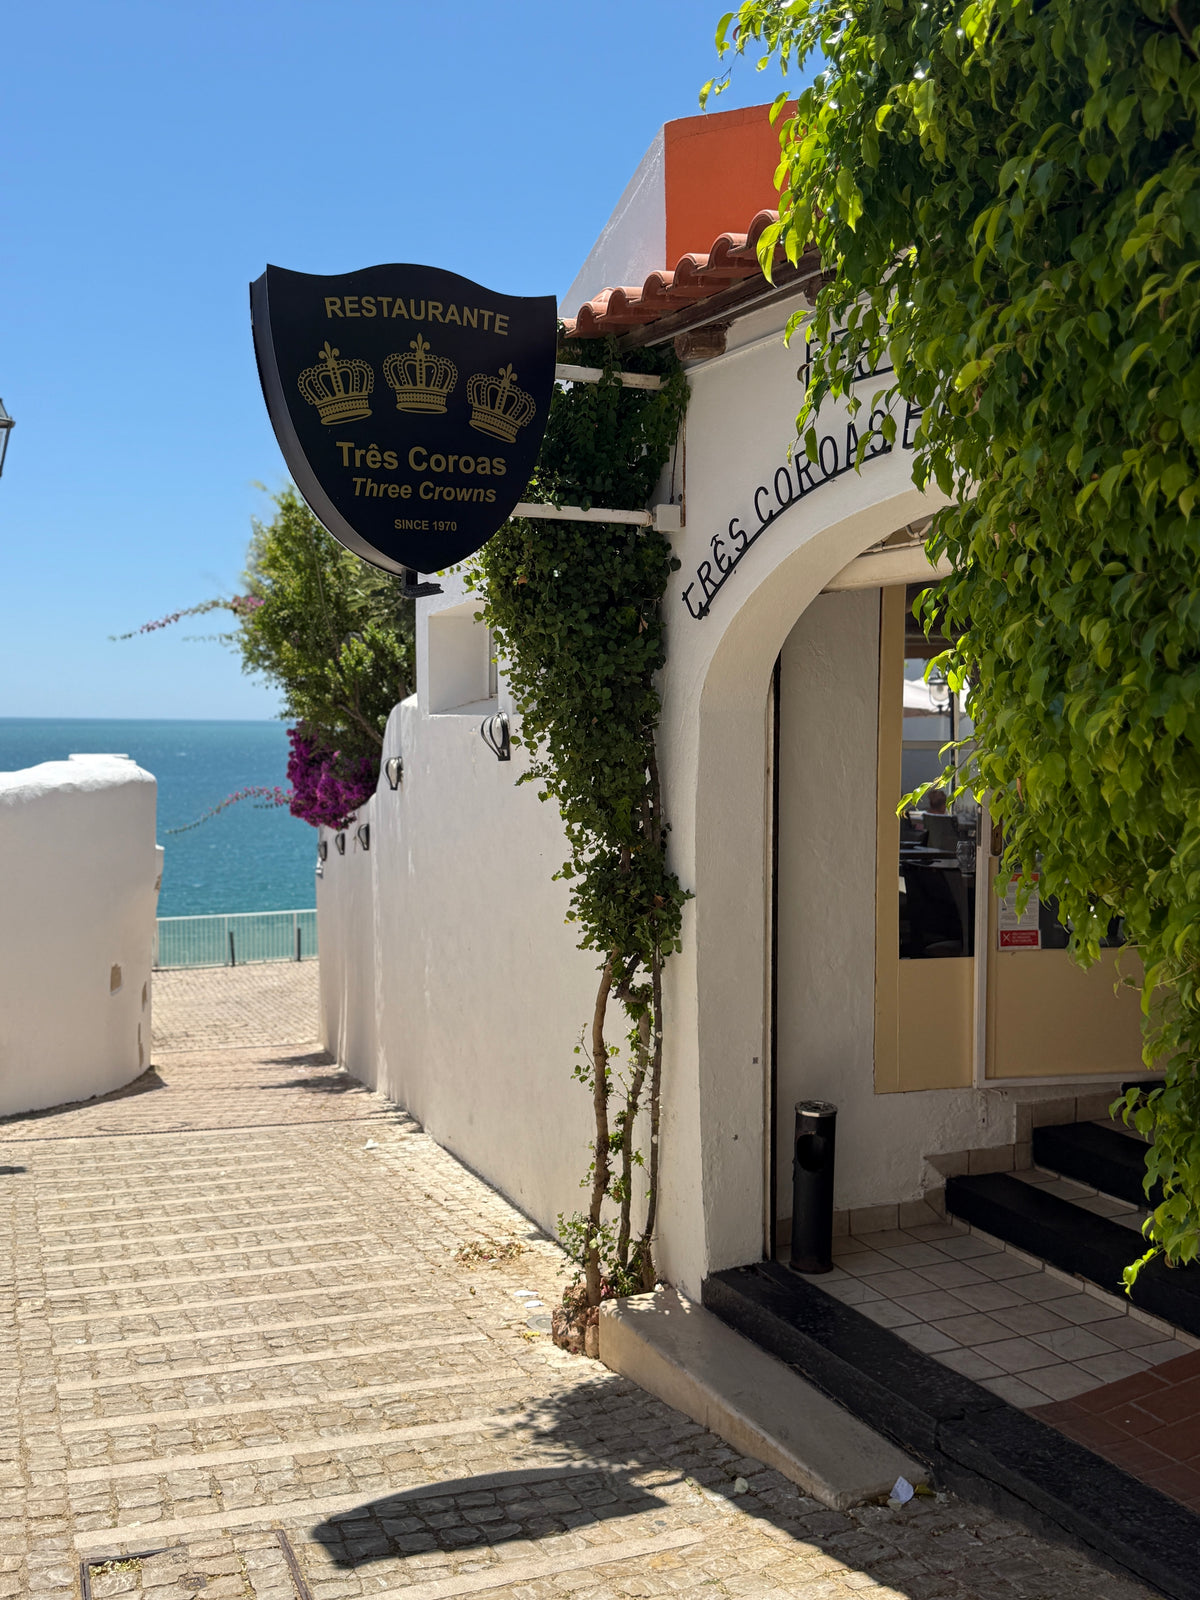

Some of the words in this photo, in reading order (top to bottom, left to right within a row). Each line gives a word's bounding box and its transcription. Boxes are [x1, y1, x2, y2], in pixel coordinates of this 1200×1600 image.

[324, 296, 510, 337] RESTAURANTE
[336, 442, 399, 470] Três
[408, 446, 507, 476] Coroas
[754, 410, 892, 525] COROAS
[352, 478, 412, 499] Three
[419, 481, 497, 504] Crowns
[394, 520, 429, 531] SINCE
[432, 521, 458, 532] 1970
